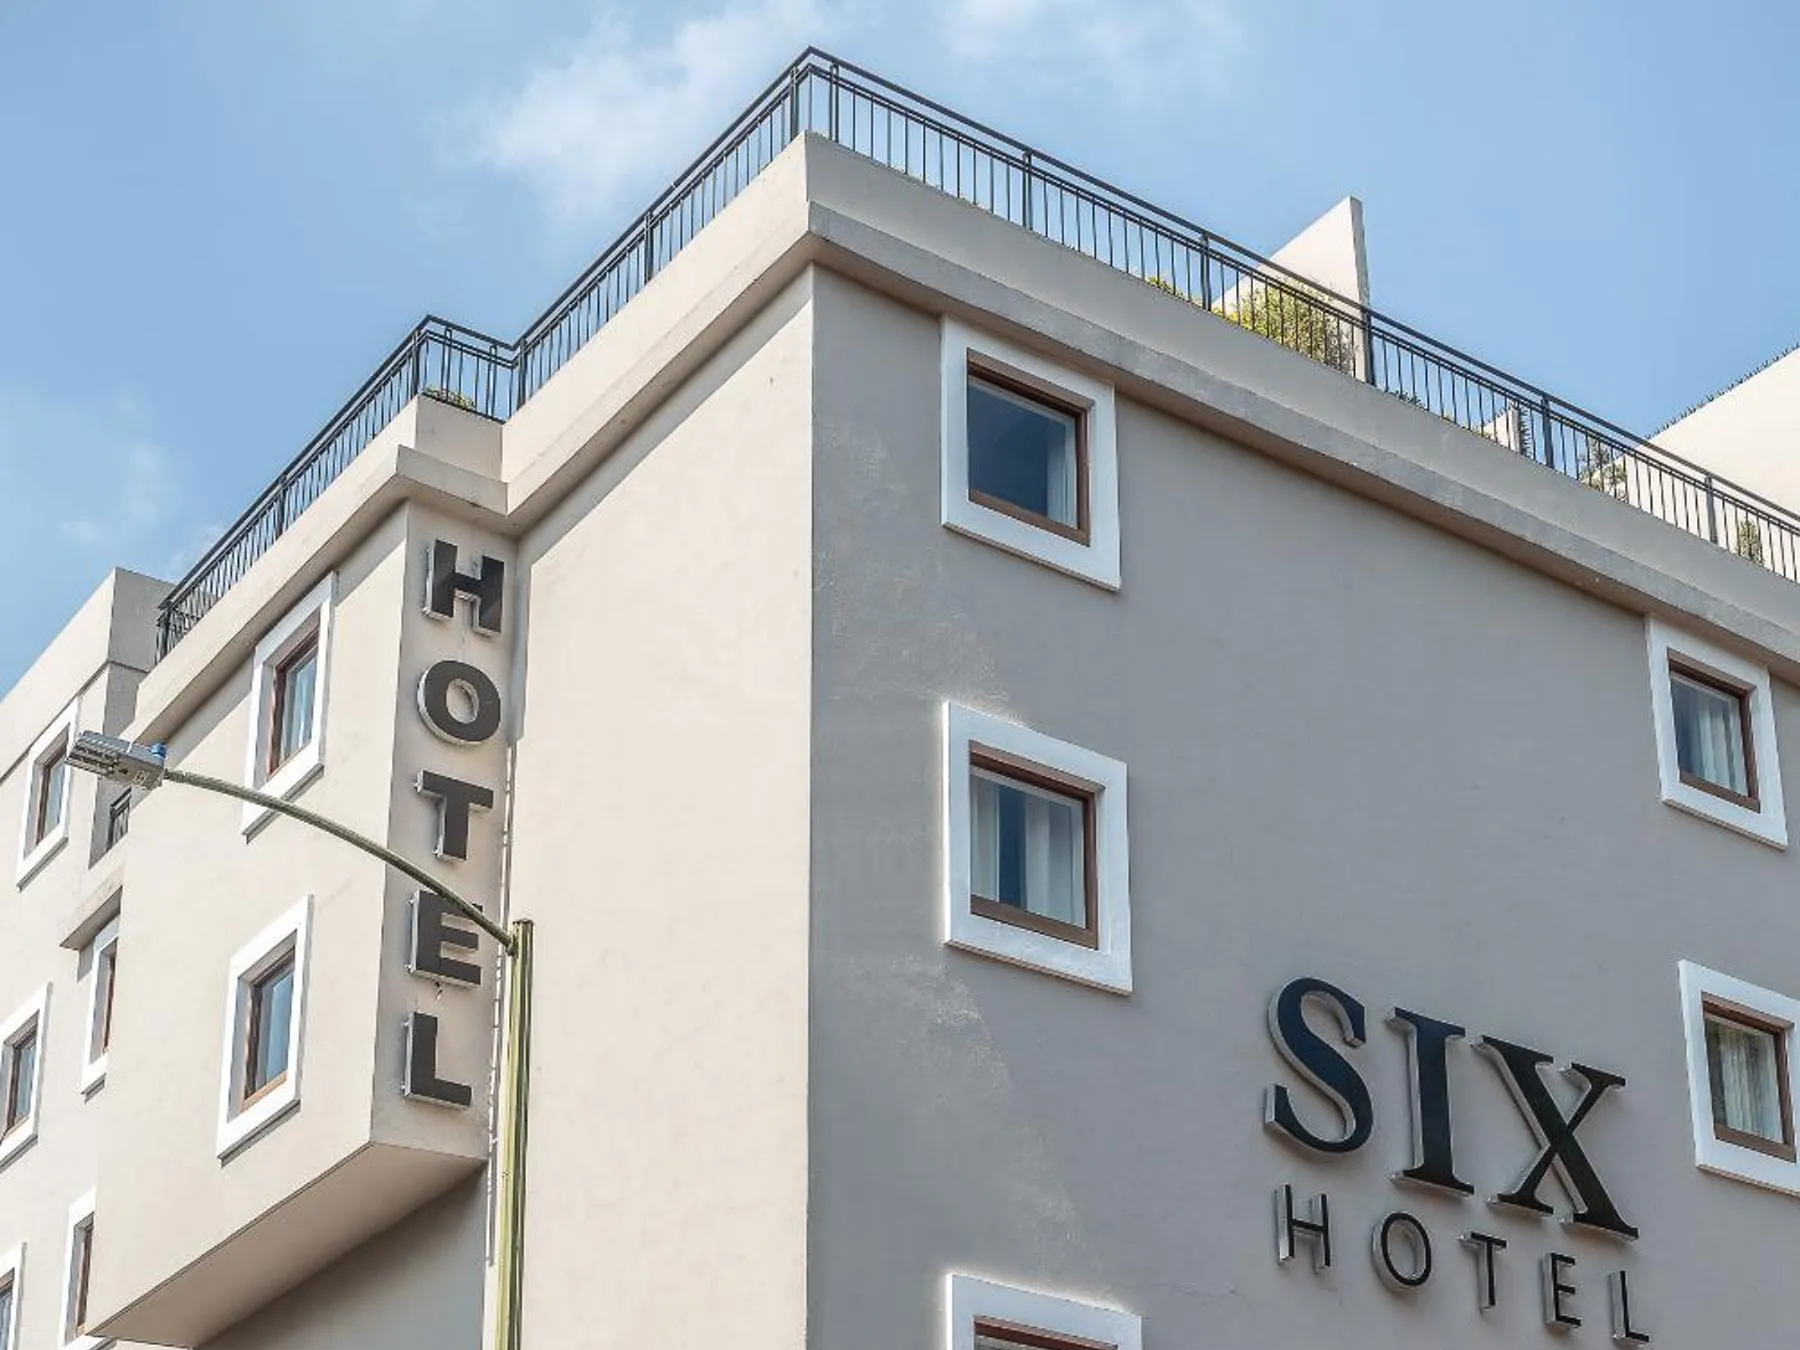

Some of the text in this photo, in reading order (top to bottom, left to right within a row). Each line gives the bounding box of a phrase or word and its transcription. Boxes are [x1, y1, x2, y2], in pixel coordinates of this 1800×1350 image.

[404, 539, 505, 1107] HOTEL
[1265, 977, 1639, 1241] SIX
[1275, 1184, 1650, 1344] HOTEL
